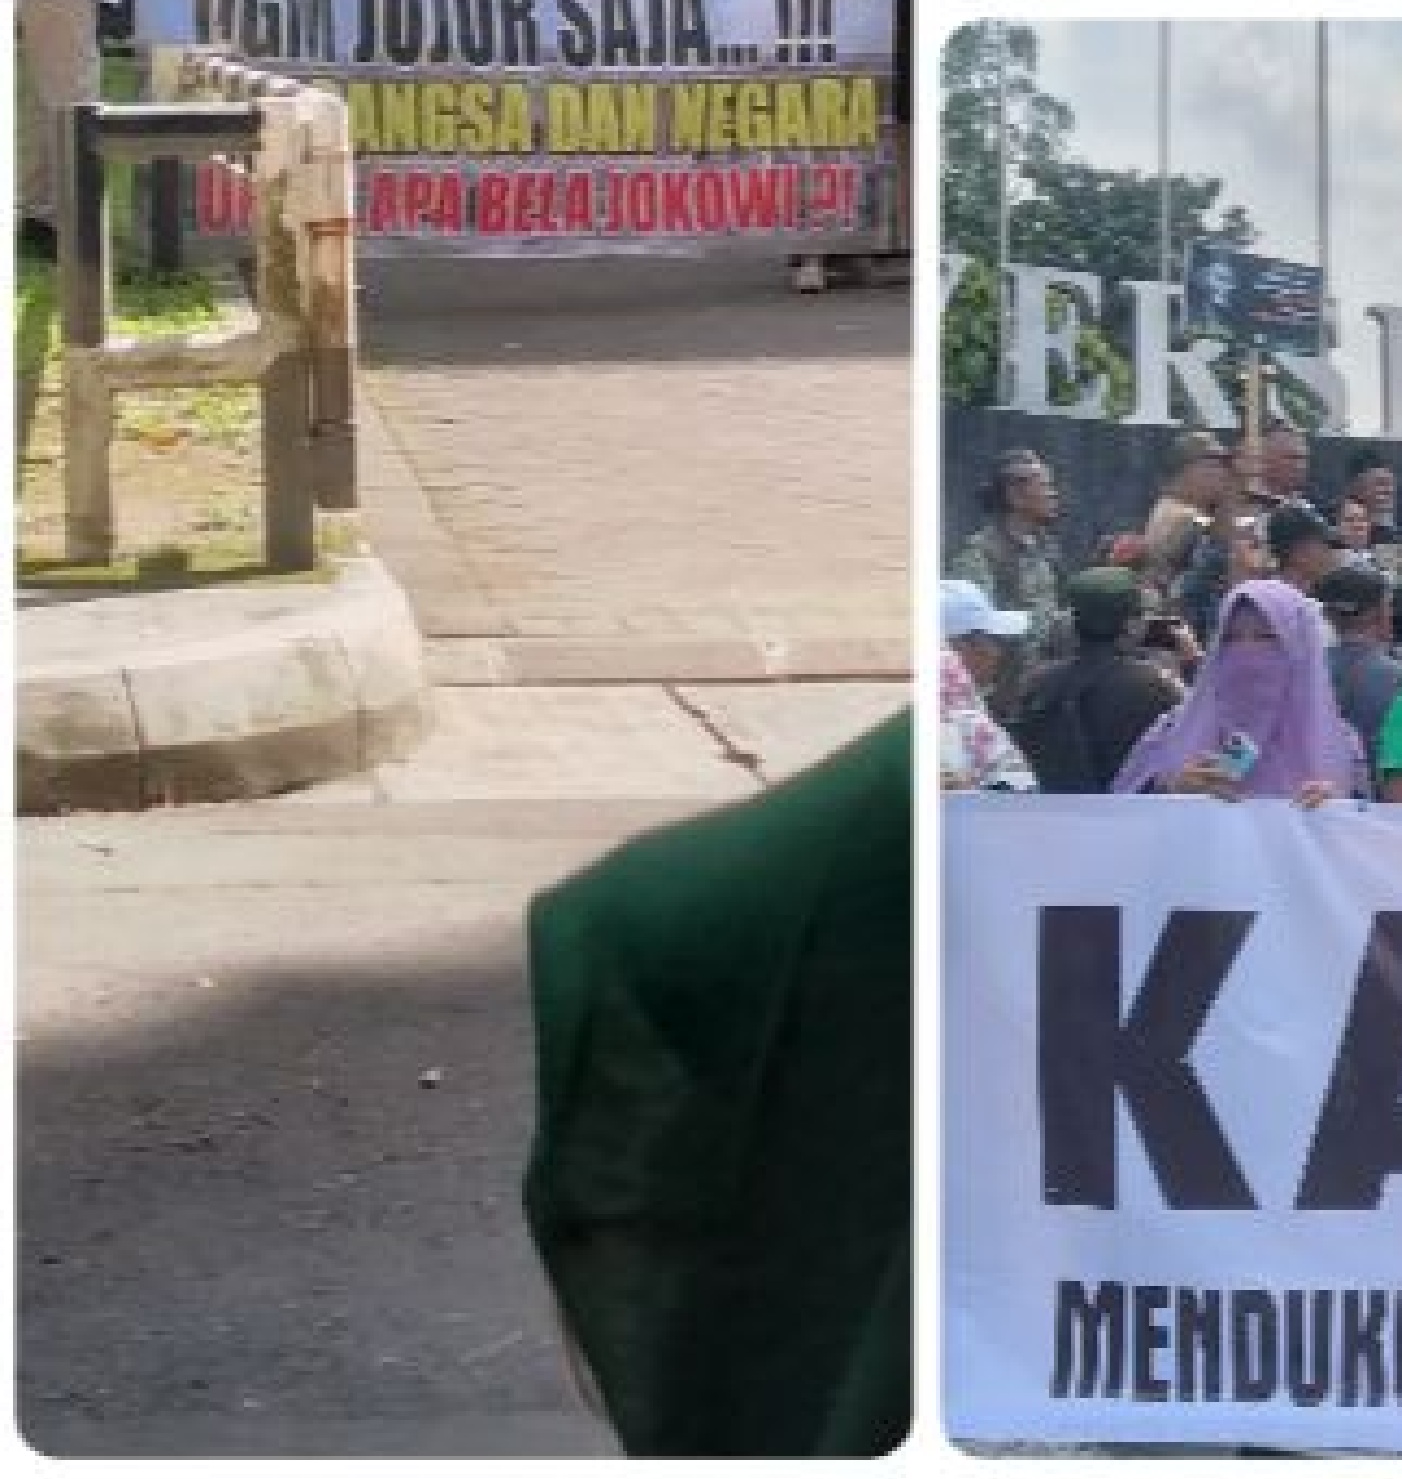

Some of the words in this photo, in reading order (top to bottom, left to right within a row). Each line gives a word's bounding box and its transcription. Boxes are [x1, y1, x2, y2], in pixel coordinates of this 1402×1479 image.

[316, 80, 528, 152] ANGSA
[548, 82, 655, 153] DAN
[672, 78, 877, 149] NEGARA
[370, 172, 462, 234] APA
[479, 170, 593, 236] BELA
